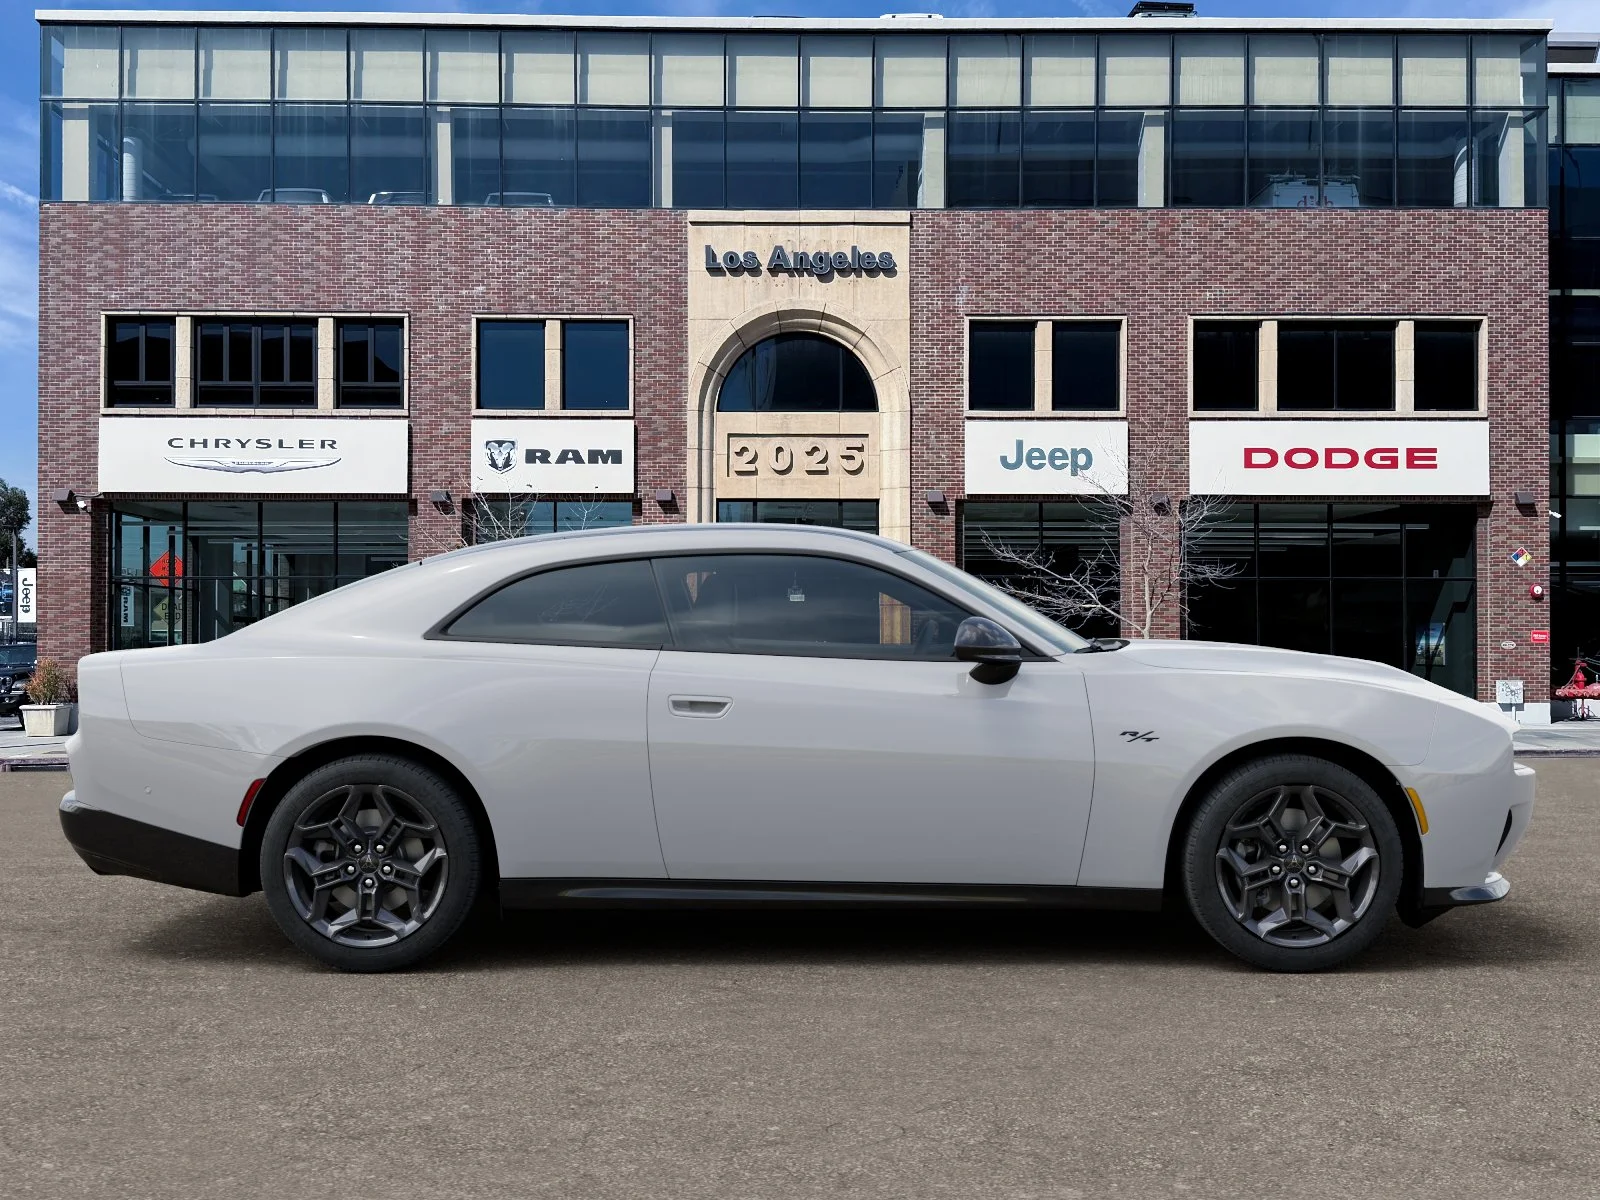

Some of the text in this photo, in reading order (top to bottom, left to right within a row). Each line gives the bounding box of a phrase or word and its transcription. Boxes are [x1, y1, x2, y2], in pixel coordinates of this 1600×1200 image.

[705, 245, 895, 276] Los Angeles
[167, 437, 338, 450] CHRYSLER
[525, 448, 623, 465] RAM
[733, 439, 865, 476] 2025
[1000, 439, 1093, 477] Jeep
[1244, 447, 1438, 470] DODGE
[20, 577, 34, 614] Jeep
[162, 603, 182, 611] DAD
[165, 612, 181, 620] ED
